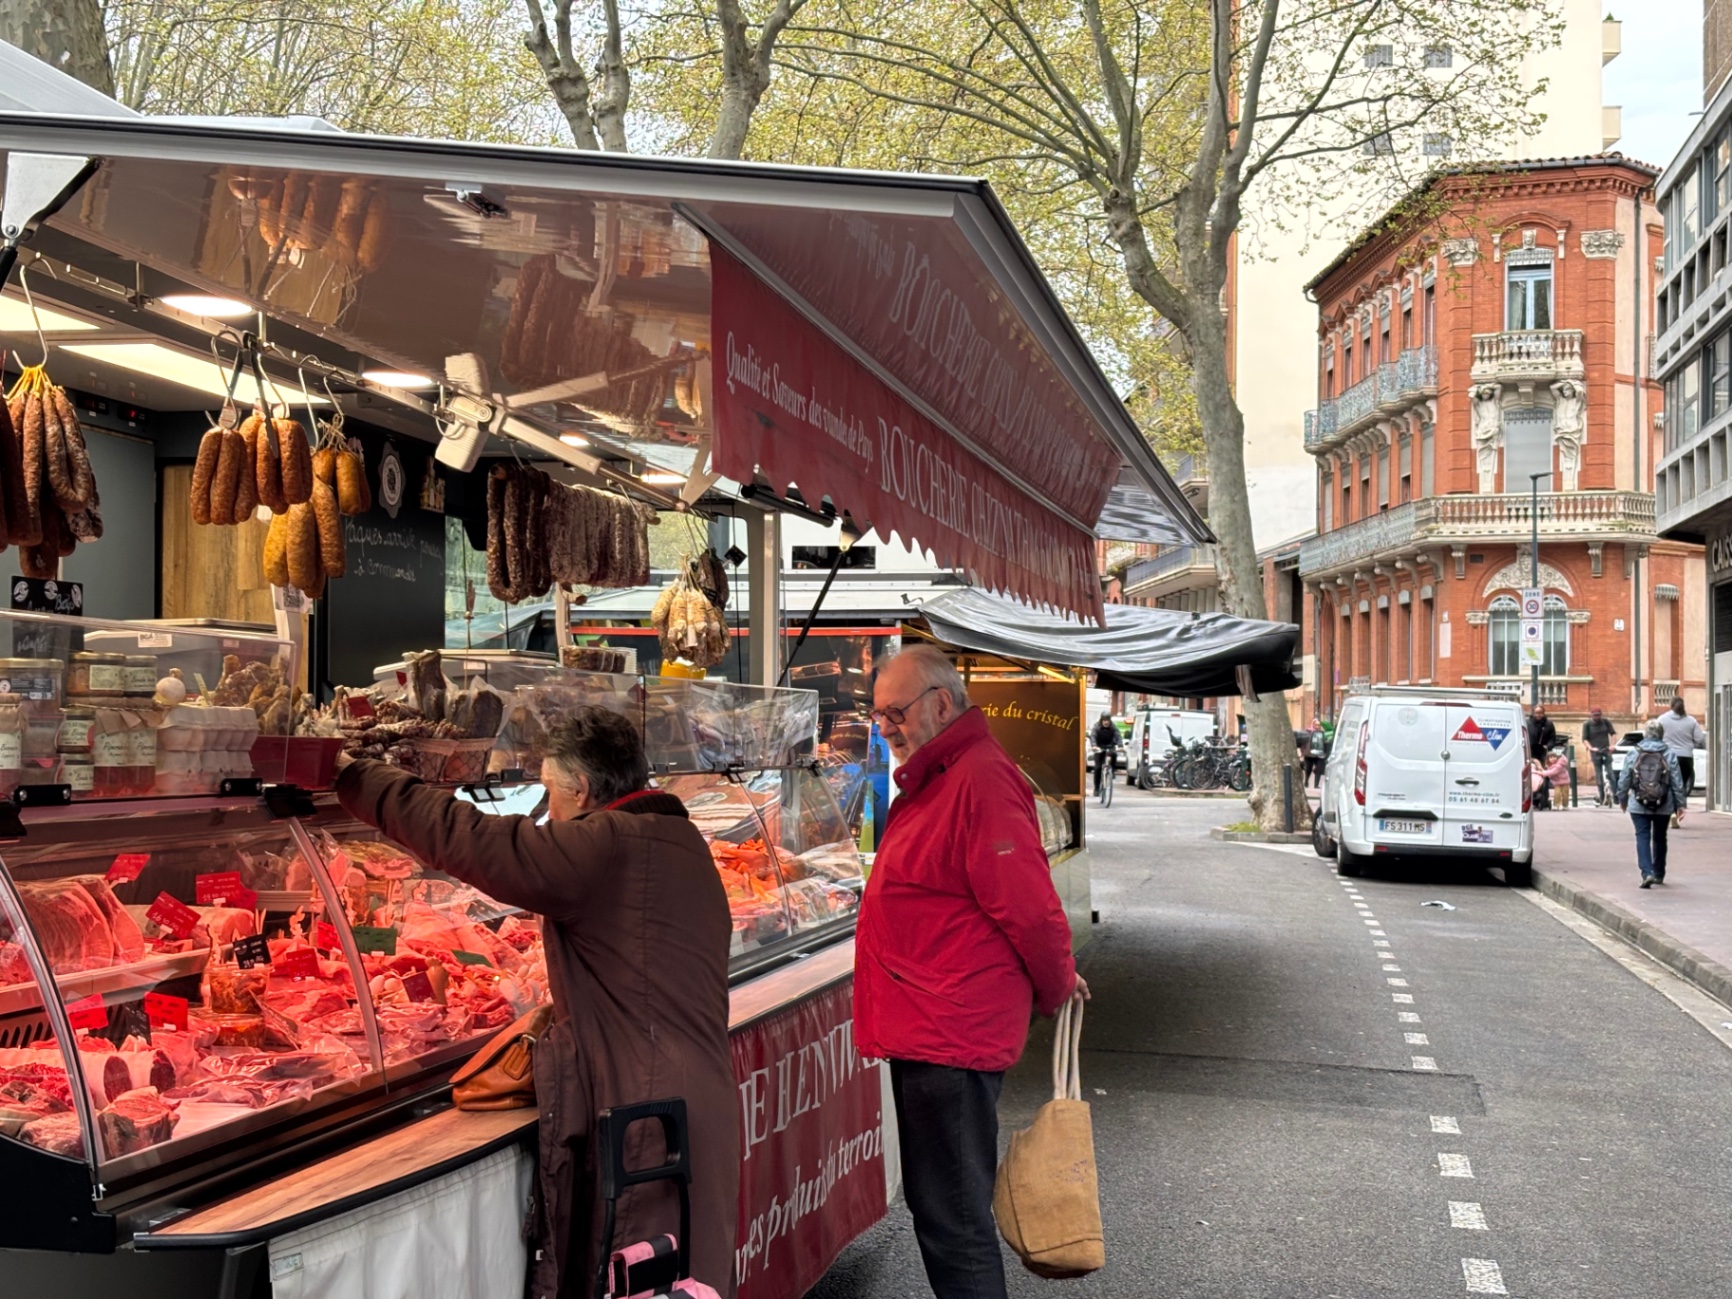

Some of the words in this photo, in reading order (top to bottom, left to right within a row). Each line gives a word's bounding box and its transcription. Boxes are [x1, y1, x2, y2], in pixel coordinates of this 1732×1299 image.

[726, 331, 761, 395] Qualité
[762, 366, 771, 400] et
[772, 362, 807, 422] Saveurs
[1002, 701, 1022, 718] du
[1026, 709, 1079, 731] cristal
[1457, 731, 1483, 740] Thermo
